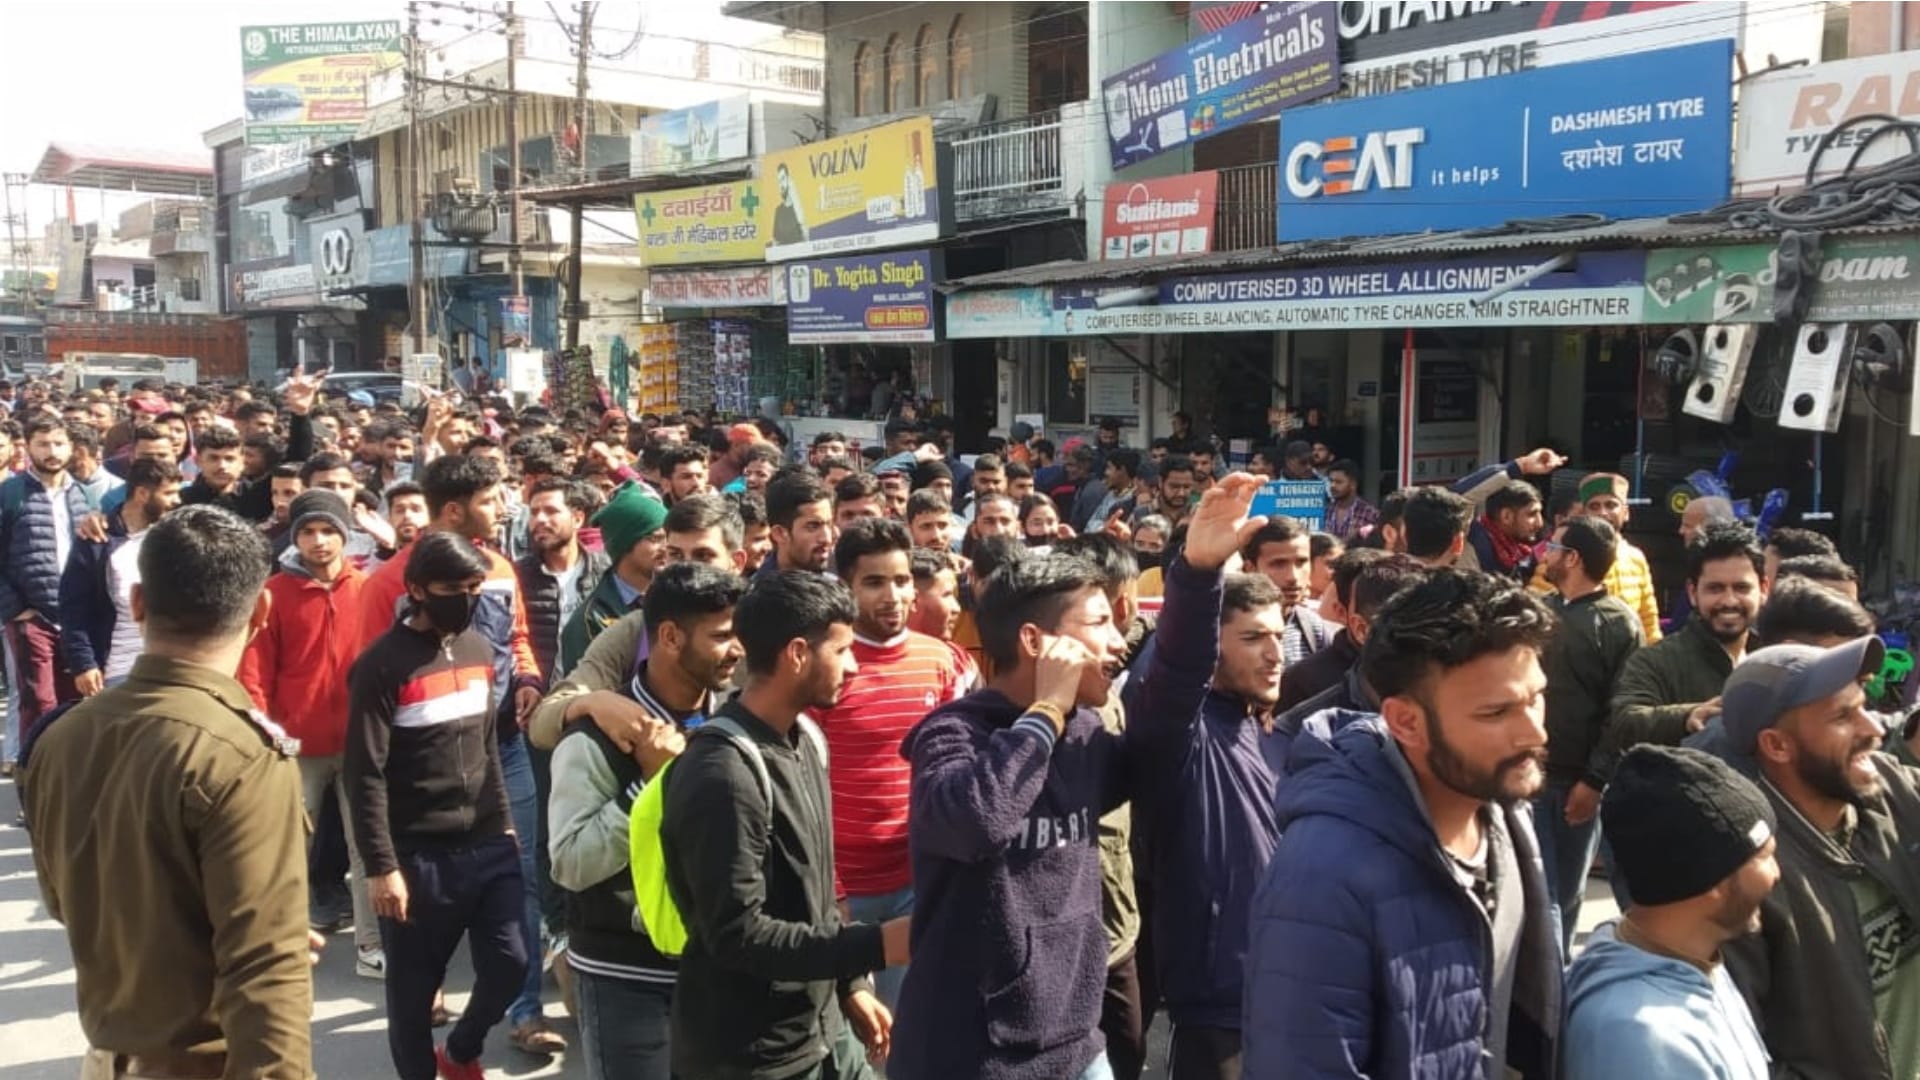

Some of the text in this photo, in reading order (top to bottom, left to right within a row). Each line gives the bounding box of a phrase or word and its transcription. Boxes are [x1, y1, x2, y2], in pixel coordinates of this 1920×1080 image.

[268, 23, 397, 44] THE HIMALAYAN
[1128, 73, 1189, 121] Monu
[1193, 13, 1325, 95] Electricals
[1459, 40, 1538, 79] TYRE
[1550, 98, 1704, 134] DASHMESH TYRE
[1285, 126, 1424, 198] CEAT
[1561, 138, 1685, 172] दशमेश टायर
[1432, 165, 1500, 187] it helps
[1116, 197, 1200, 224] Sunflame
[813, 259, 925, 292] Dr. Yogita Singh
[1173, 264, 1531, 302] COMPUTERISED 3D WHEEL ALLIGNMENT
[1086, 297, 1630, 329] COMPUTERISED WHEEL BALANCING, AUTOMATIC TYRE CHANGER, RIM STRAIGHTNER
